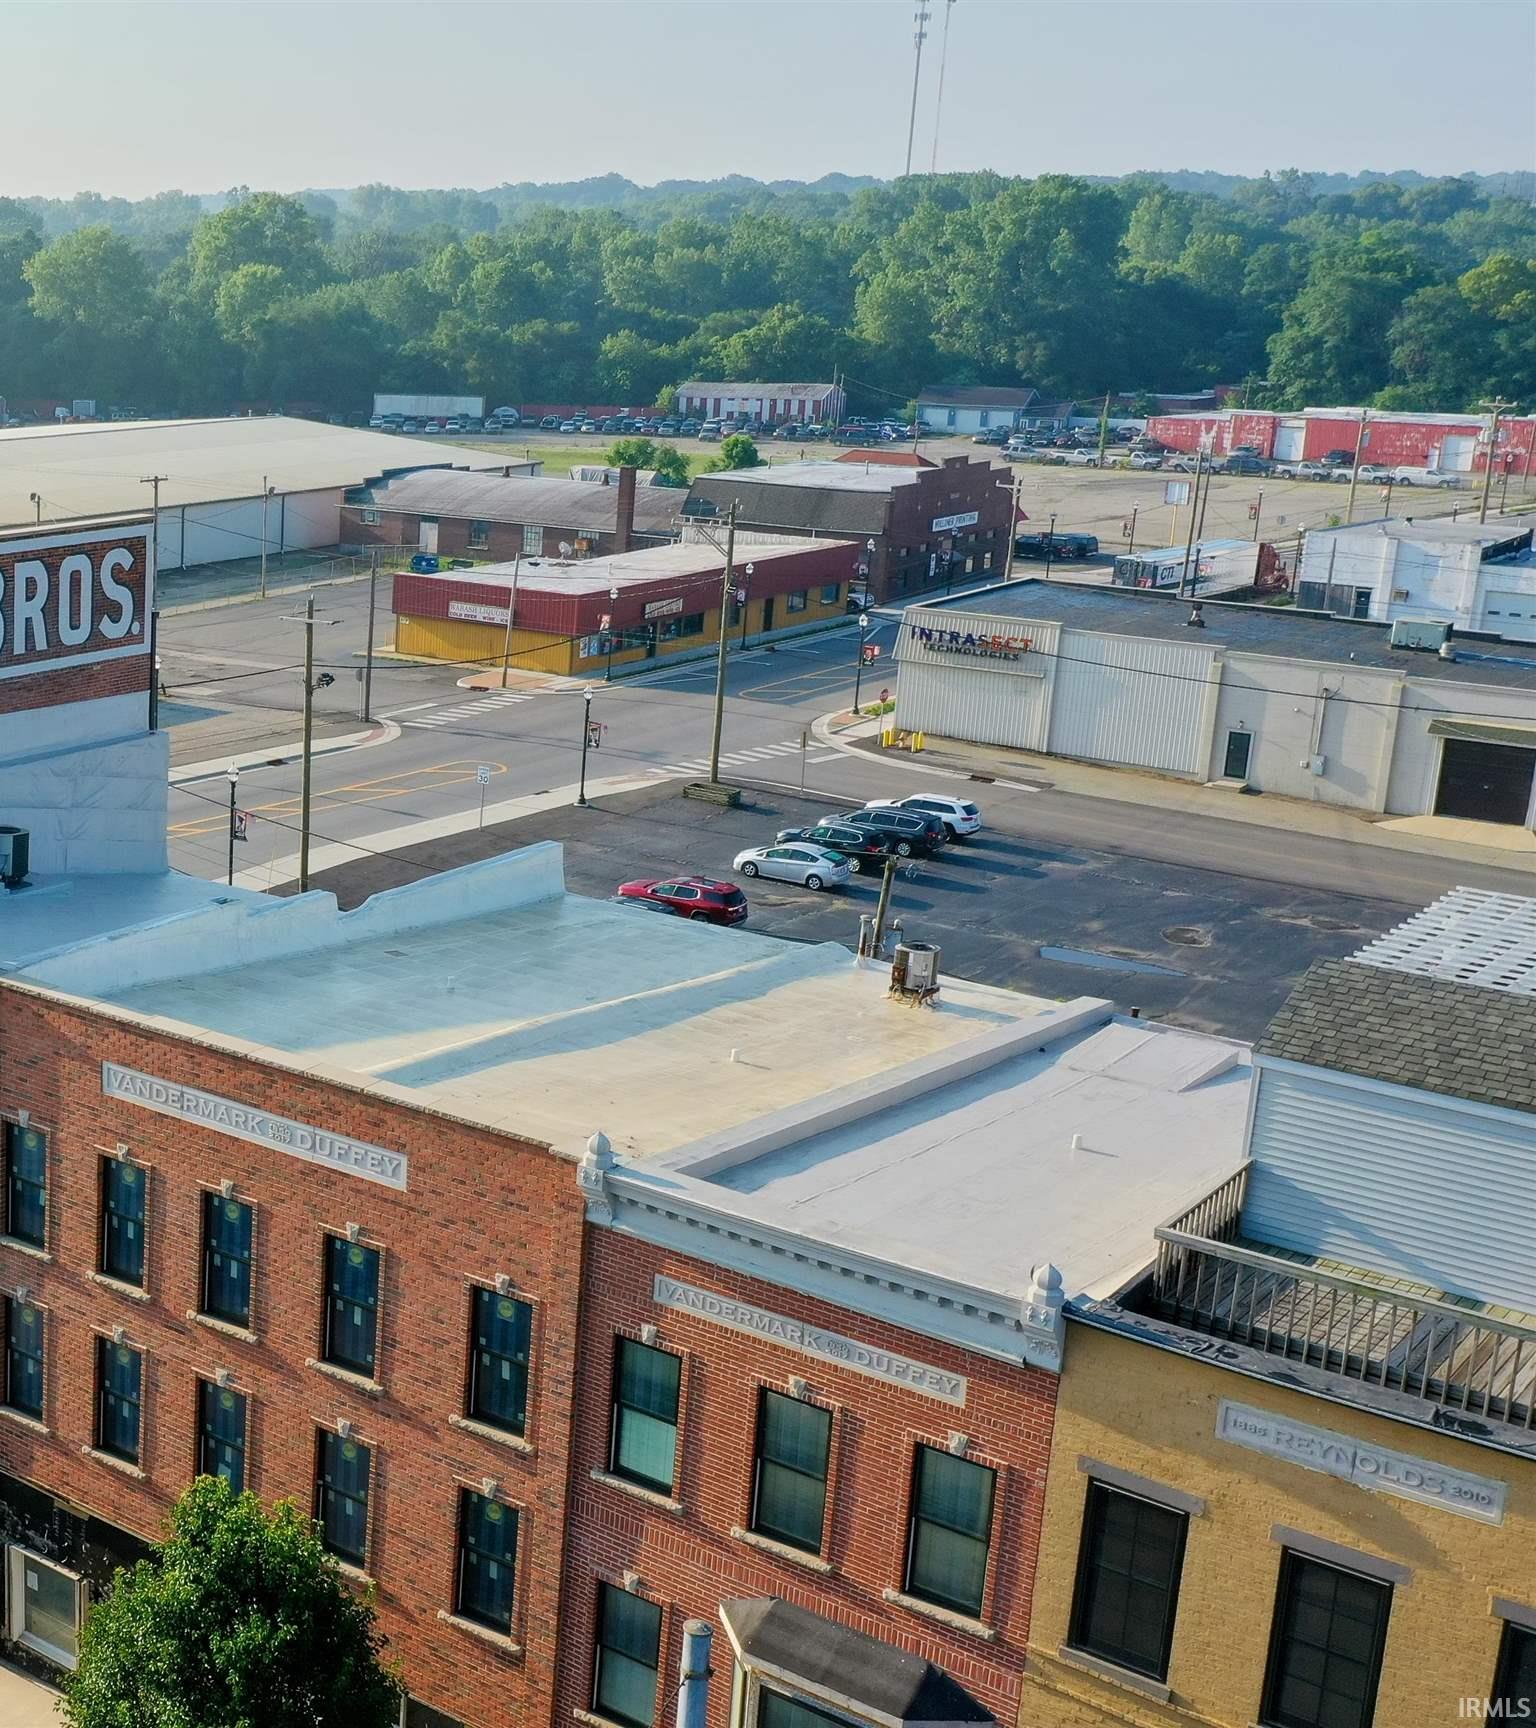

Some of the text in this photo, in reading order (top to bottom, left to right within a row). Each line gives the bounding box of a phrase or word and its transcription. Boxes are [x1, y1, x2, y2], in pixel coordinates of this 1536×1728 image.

[911, 625, 1033, 654] INTRASECT
[923, 642, 1020, 662] TECHNOLOGIES
[478, 774, 488, 784] 30
[110, 1069, 400, 1177] VANDERMARK DUFFEY
[665, 1282, 961, 1395] VANDERMARK DUFFEY
[1274, 1430, 1445, 1494] REYNOLDS
[1449, 1486, 1491, 1505] 2010
